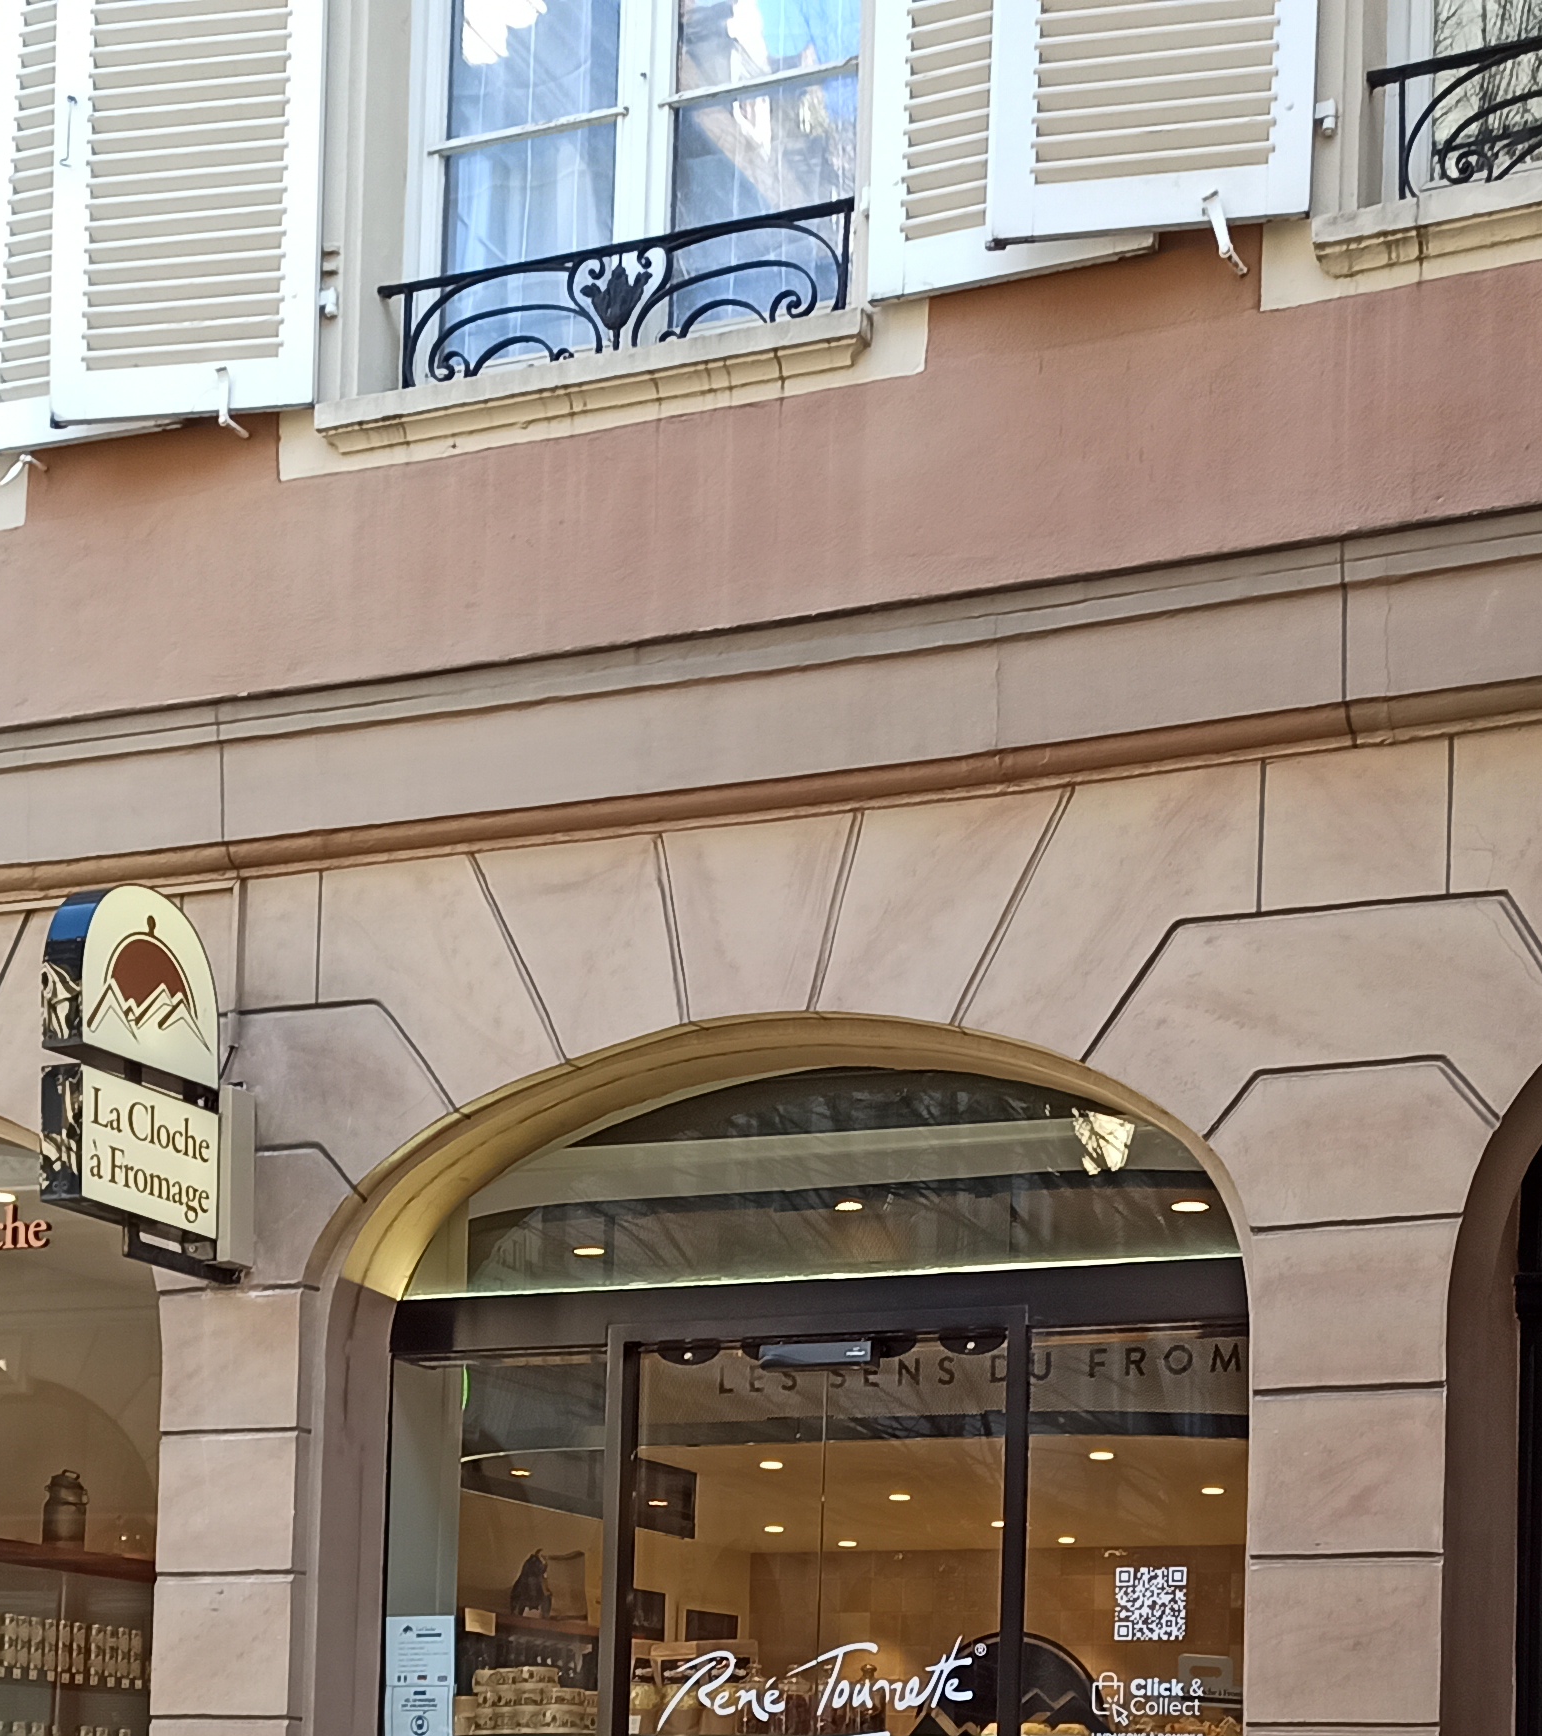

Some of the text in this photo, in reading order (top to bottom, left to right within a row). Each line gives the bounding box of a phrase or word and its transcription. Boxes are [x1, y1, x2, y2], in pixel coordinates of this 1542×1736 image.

[90, 1086, 211, 1164] La Cloche
[89, 1139, 211, 1224] à Fromage
[830, 1355, 956, 1390] SENS
[1088, 1342, 1241, 1379] FROM
[656, 1650, 785, 1733] René
[1129, 1697, 1201, 1716] Collect
[1130, 1677, 1185, 1697] Click
[1189, 1678, 1204, 1697] &
